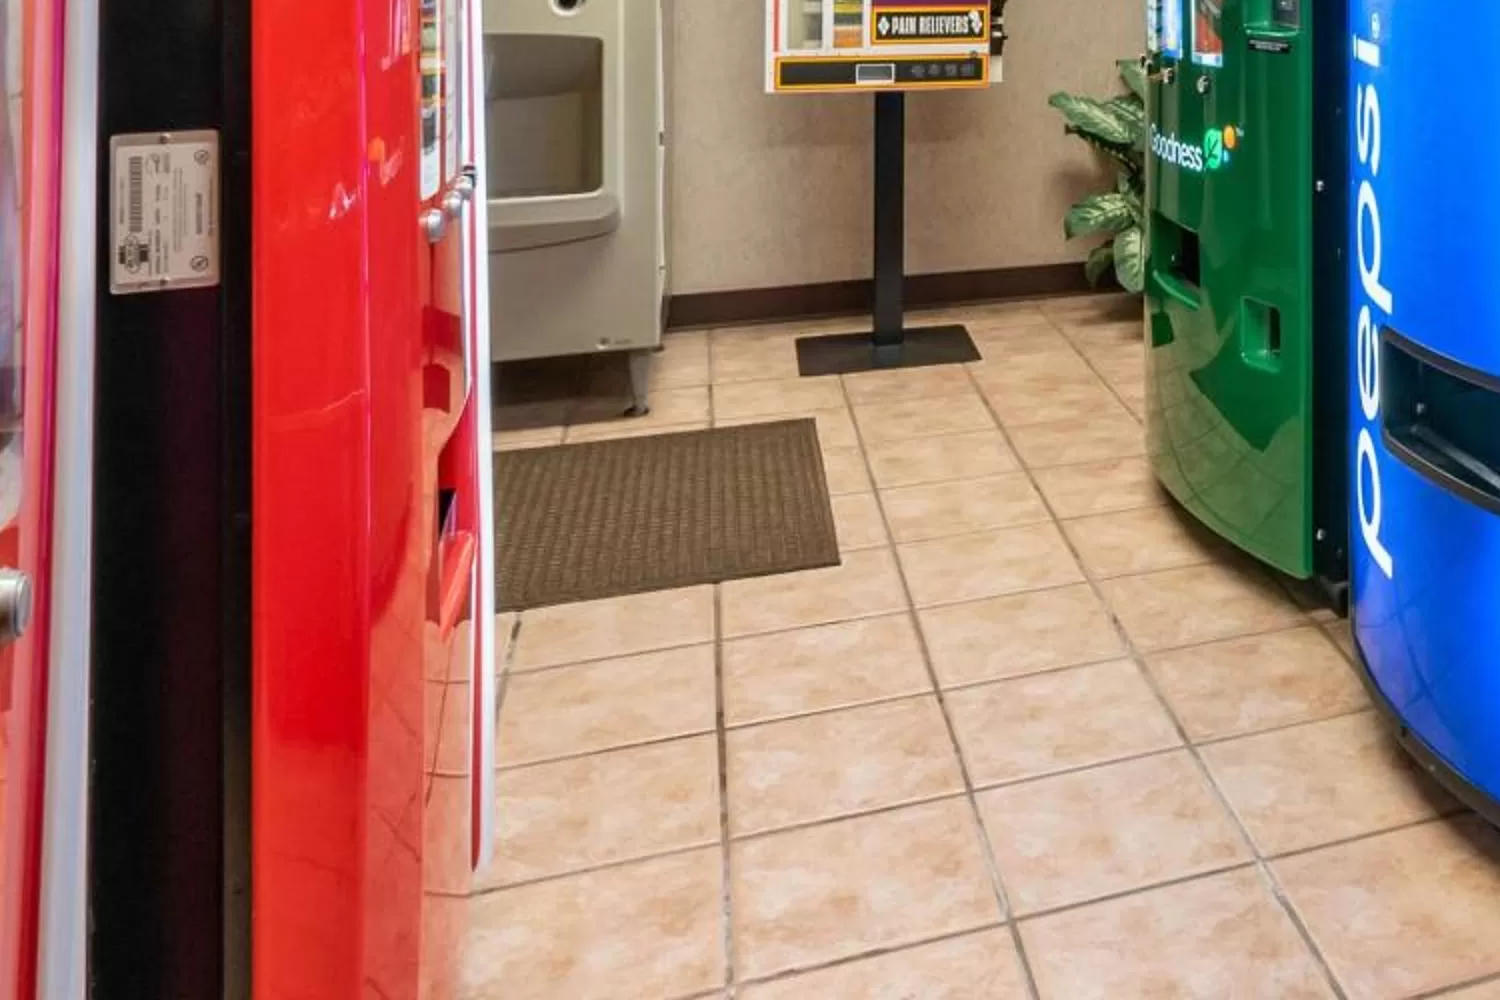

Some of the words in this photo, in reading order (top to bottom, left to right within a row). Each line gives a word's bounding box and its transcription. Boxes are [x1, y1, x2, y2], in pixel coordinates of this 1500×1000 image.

[891, 15, 916, 35] PAIN
[919, 14, 970, 35] RELIEVERS
[1353, 34, 1393, 578] pepsi
